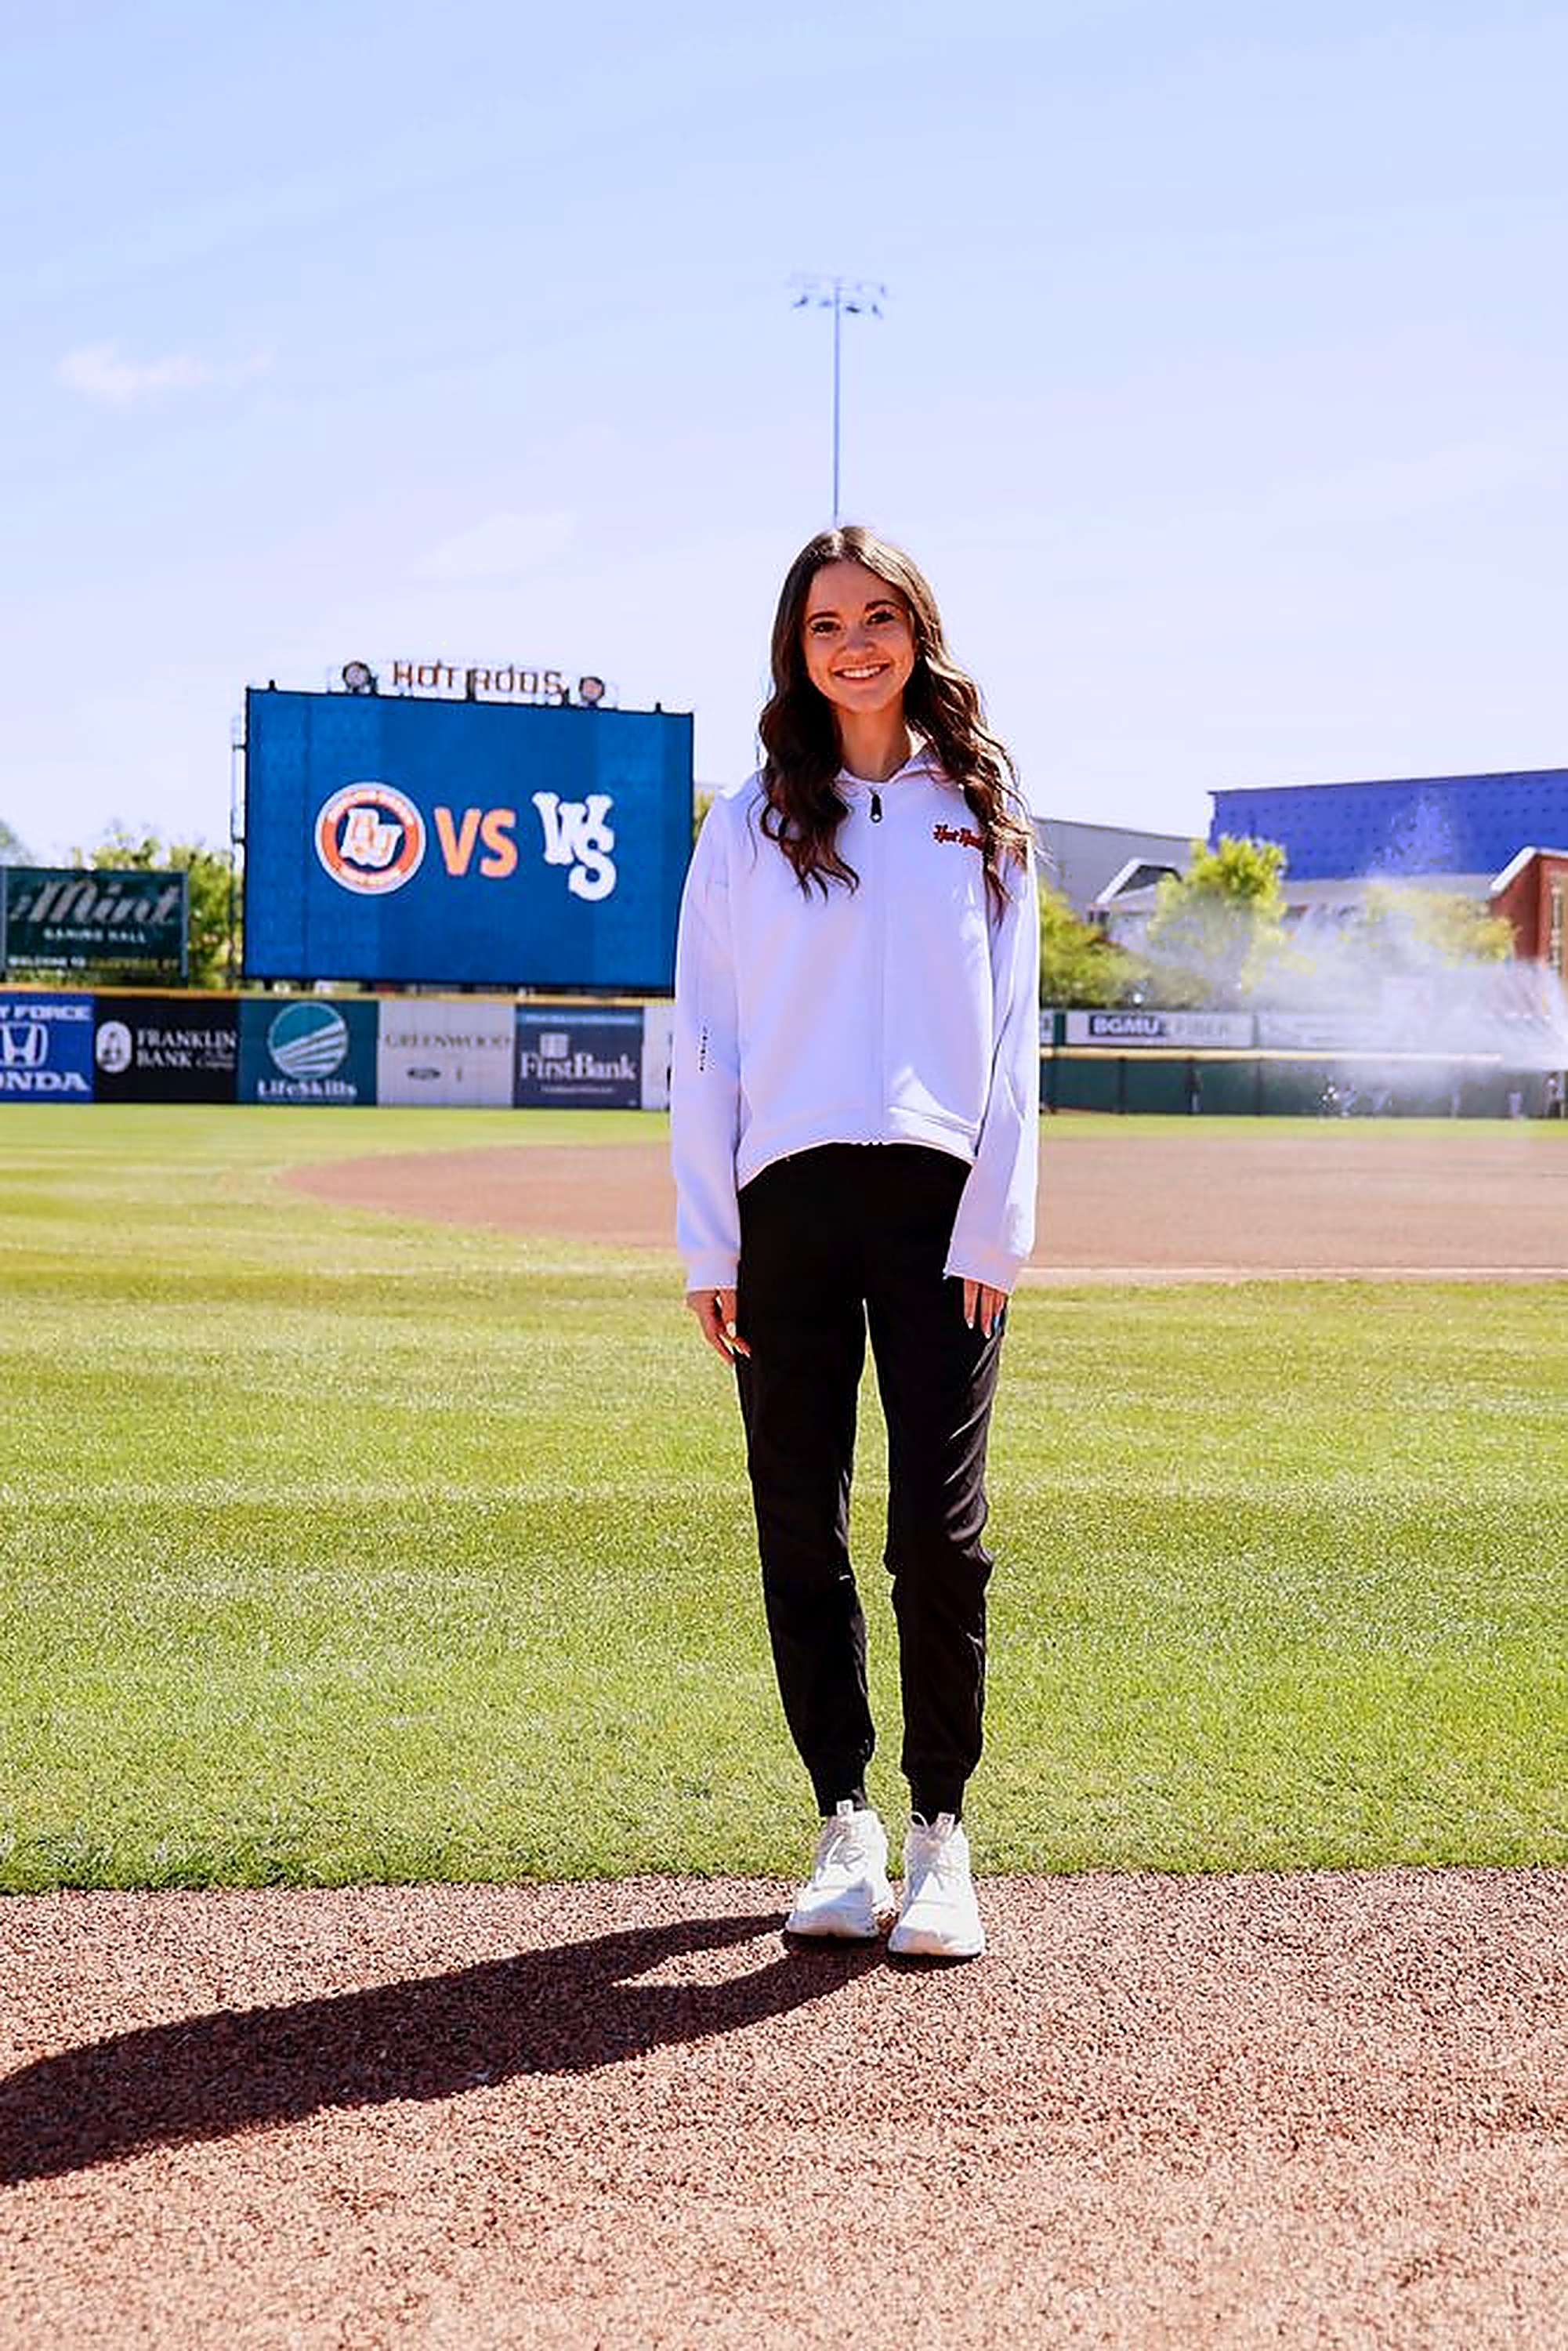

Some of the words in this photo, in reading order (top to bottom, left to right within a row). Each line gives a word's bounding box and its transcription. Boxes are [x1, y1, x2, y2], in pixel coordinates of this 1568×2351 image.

[393, 661, 459, 688] HOT
[433, 807, 518, 878] VS
[1092, 1018, 1159, 1034] BGMU
[136, 1029, 237, 1048] FRANKLIN
[136, 1049, 192, 1067] BANK
[519, 1052, 639, 1081] FirstBank
[0, 1071, 91, 1091] NDA
[256, 1078, 358, 1096] LifeSkills
